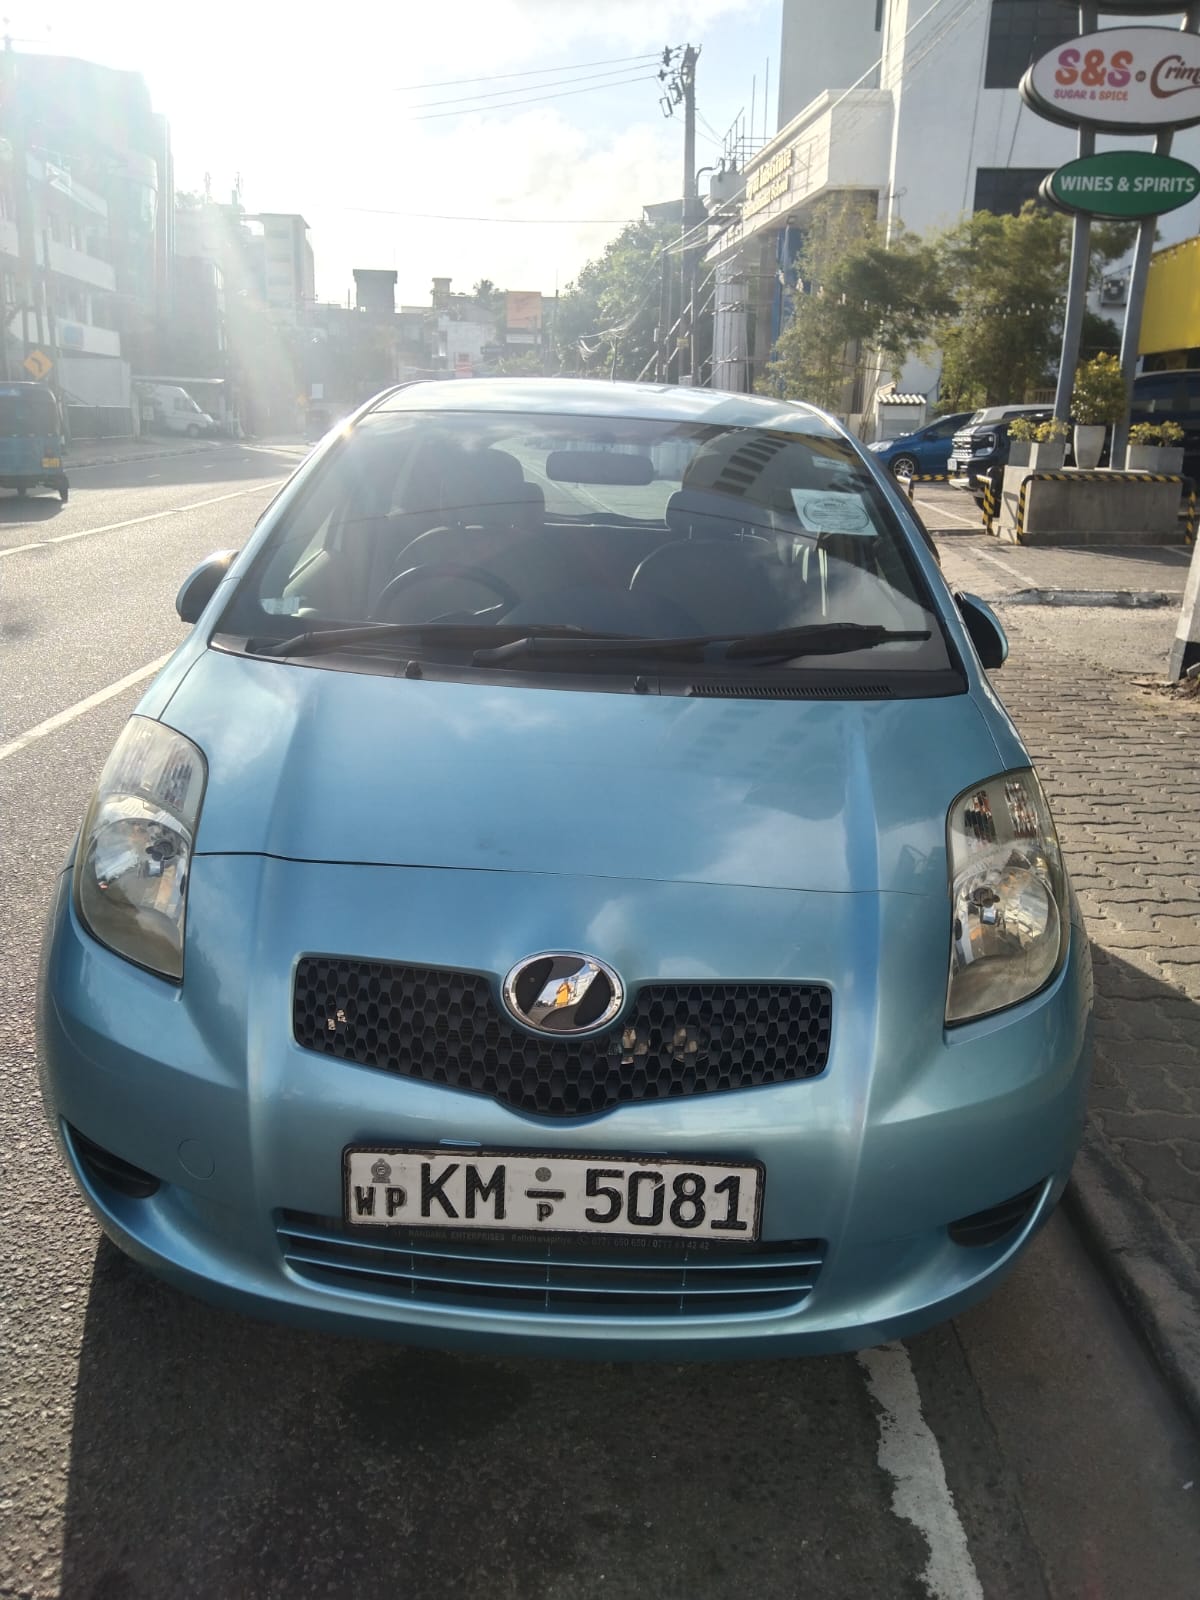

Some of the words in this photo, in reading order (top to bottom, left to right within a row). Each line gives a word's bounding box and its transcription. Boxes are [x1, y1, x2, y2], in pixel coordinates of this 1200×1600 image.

[1055, 49, 1133, 87] S&S
[1150, 55, 1200, 99] Crim
[1054, 88, 1087, 100] SUGAR
[1089, 90, 1096, 100] &
[1099, 90, 1129, 101] SPICE
[1060, 176, 1113, 191] WINES
[1117, 177, 1129, 191] &
[1133, 177, 1195, 192] SPIRITS
[421, 1163, 505, 1219] KM
[585, 1168, 747, 1230] 5081
[537, 1203, 553, 1222] P
